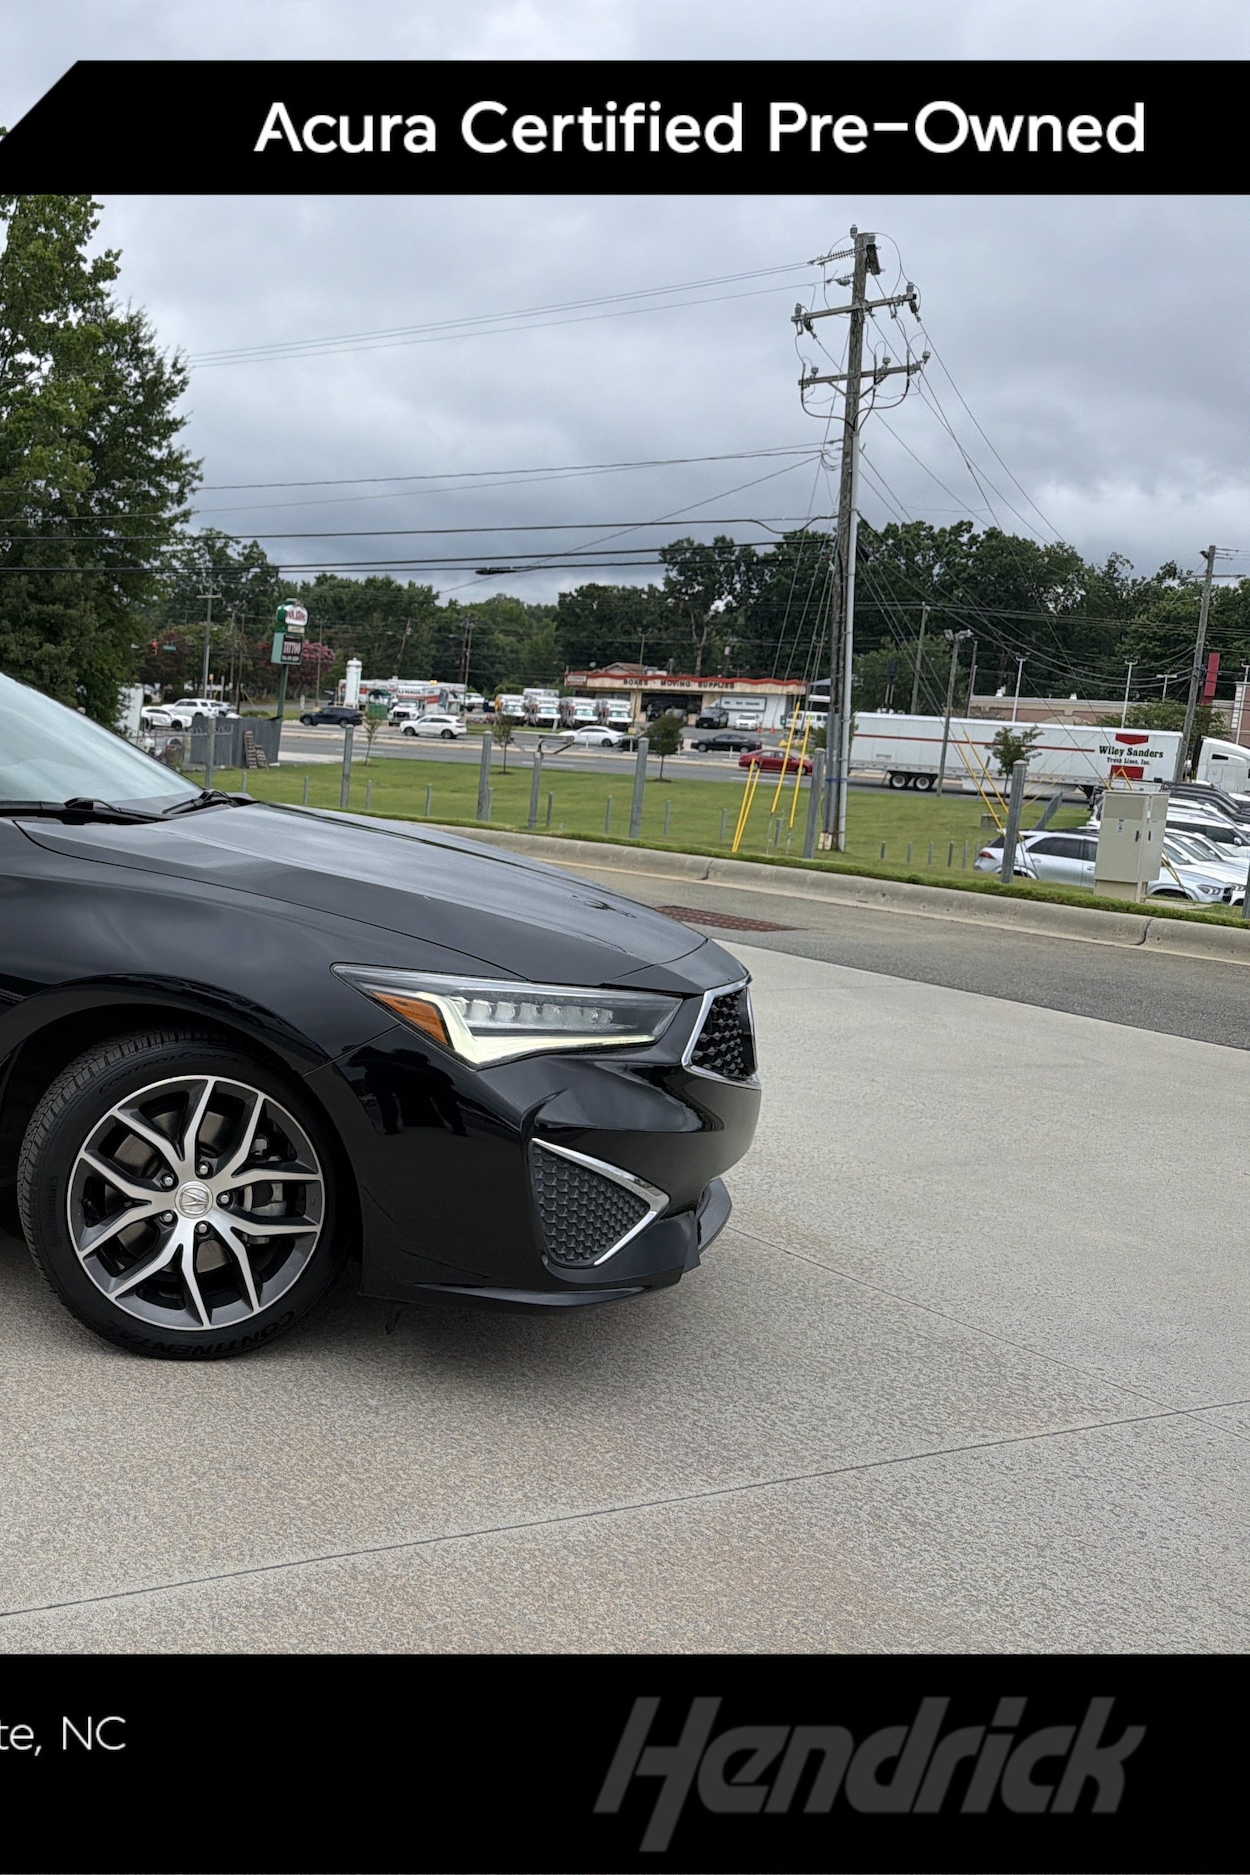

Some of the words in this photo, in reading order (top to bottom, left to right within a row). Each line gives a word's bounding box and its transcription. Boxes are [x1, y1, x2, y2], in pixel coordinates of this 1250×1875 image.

[623, 678, 649, 686] BOXES
[660, 679, 691, 688] MOVING
[697, 681, 735, 690] SUPPLIES
[1099, 745, 1125, 758] Wiley
[1126, 747, 1164, 759] Sanders
